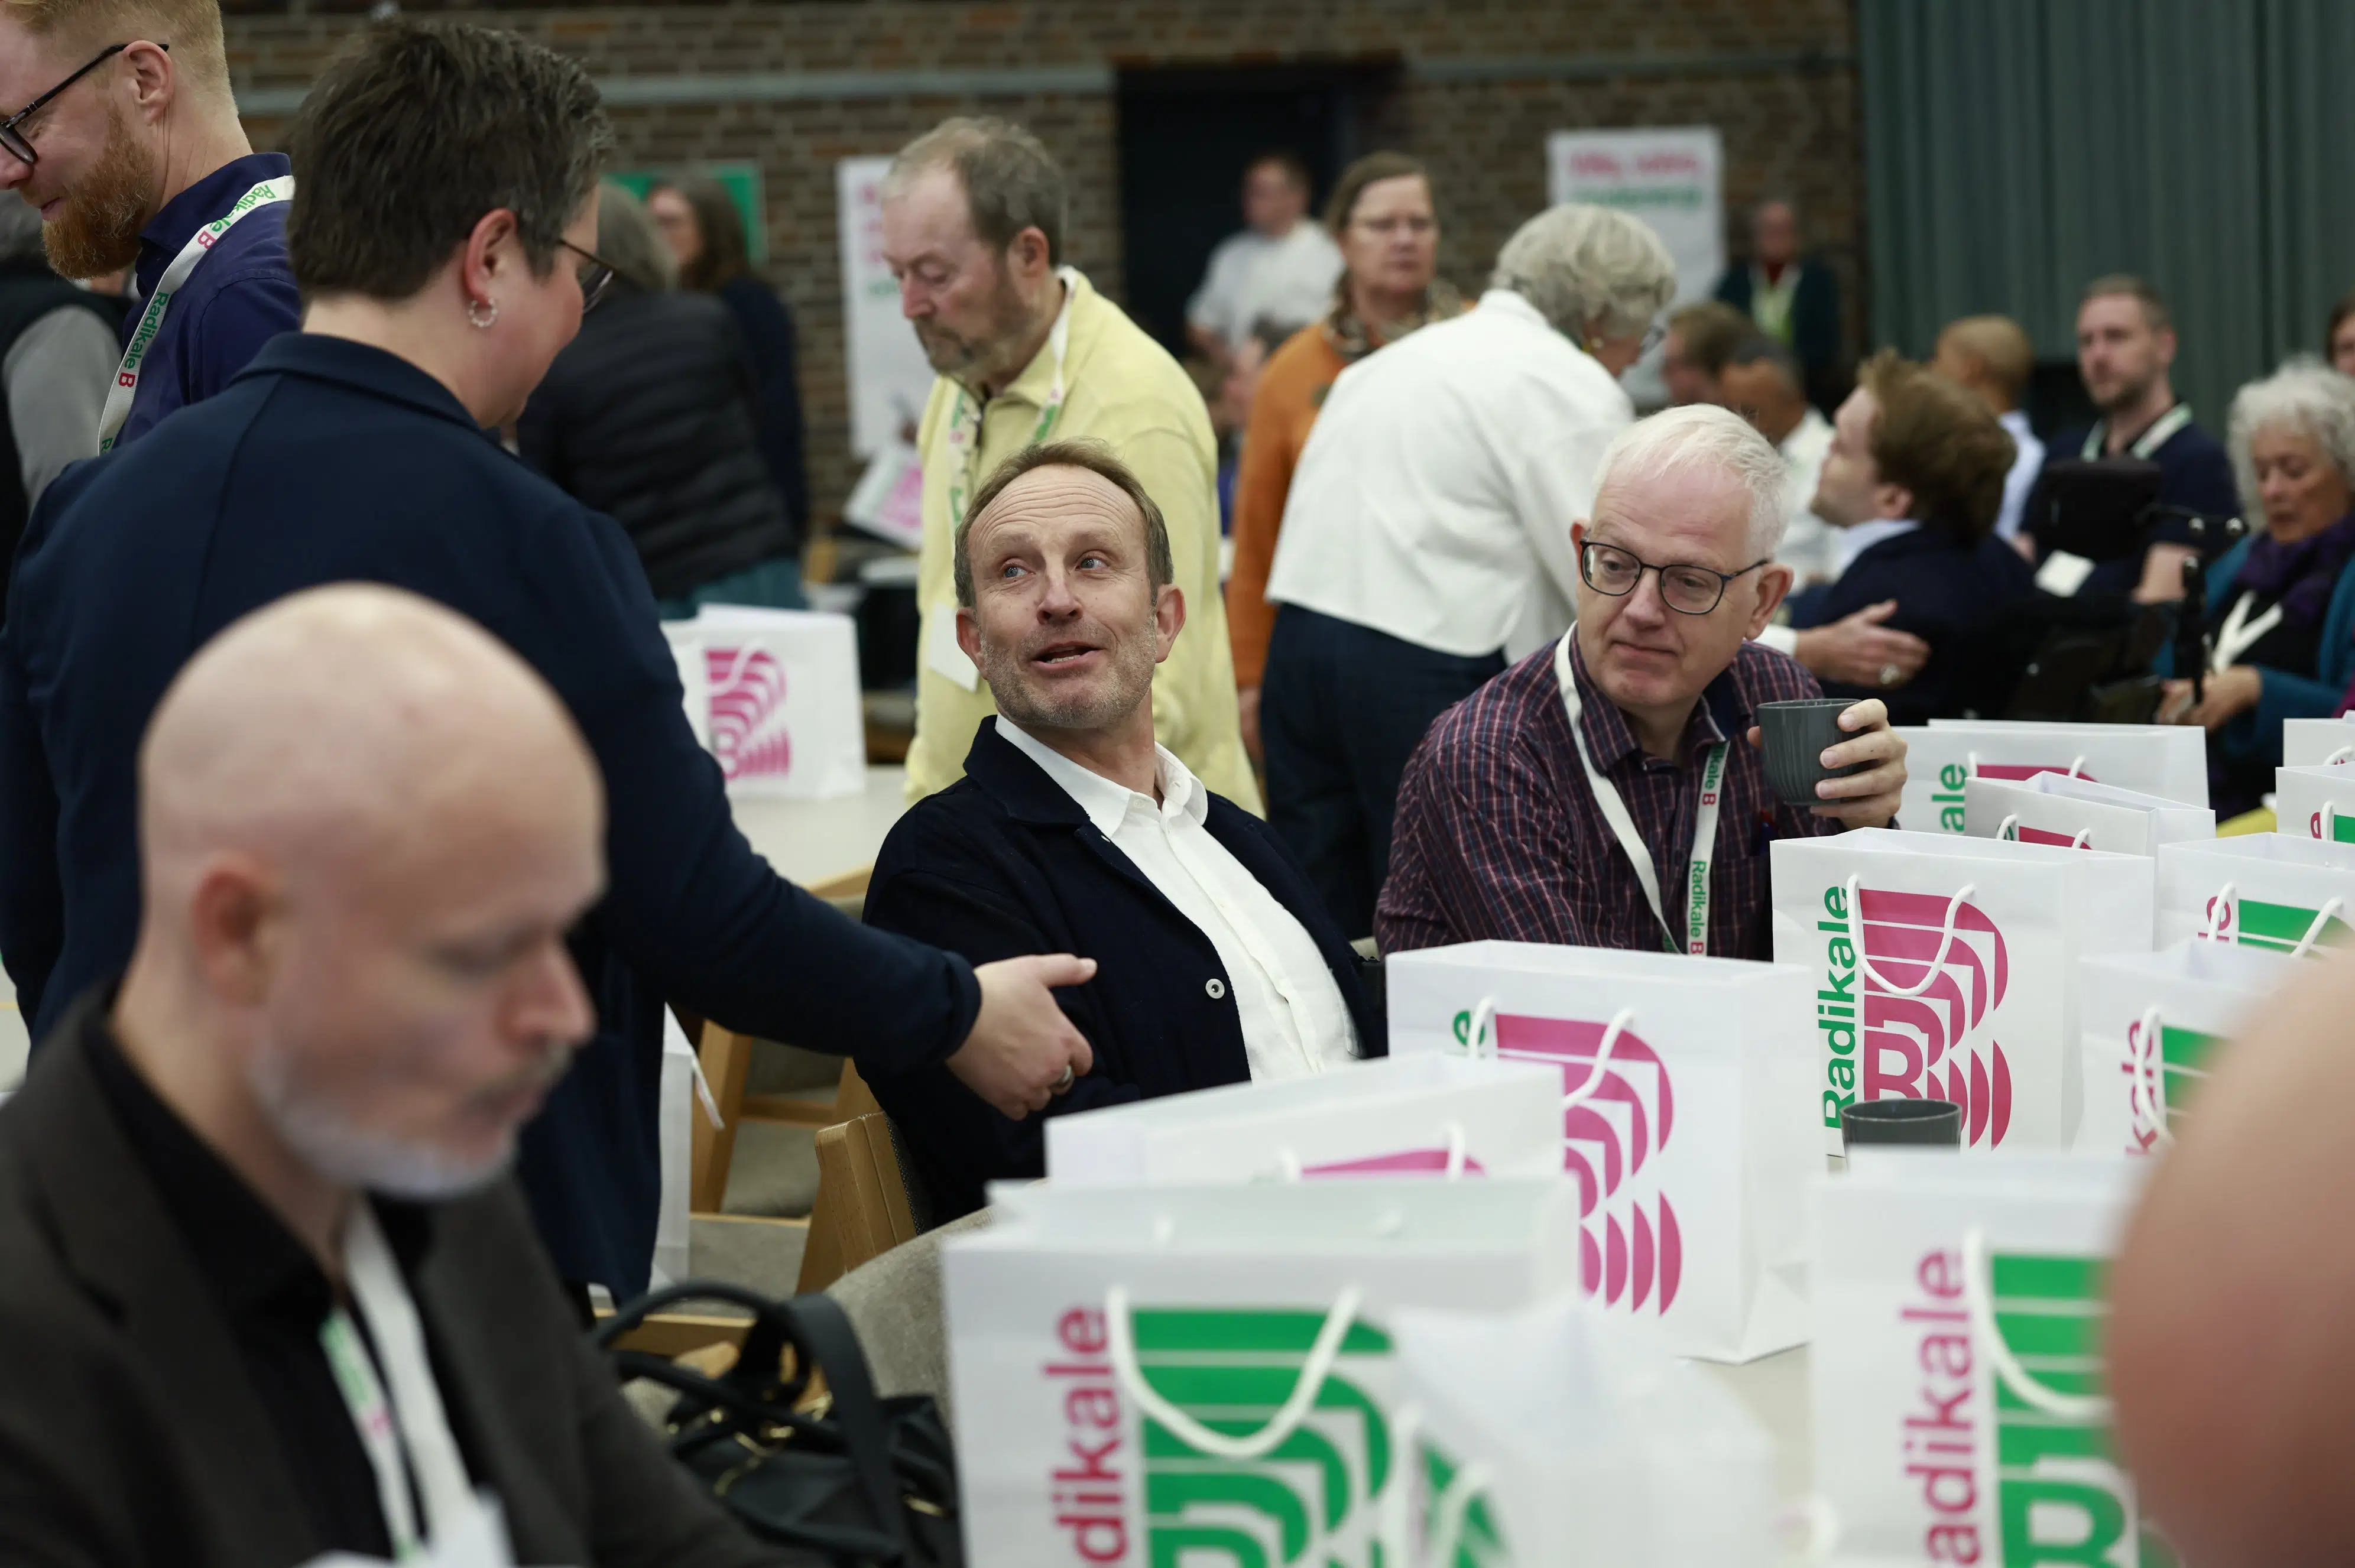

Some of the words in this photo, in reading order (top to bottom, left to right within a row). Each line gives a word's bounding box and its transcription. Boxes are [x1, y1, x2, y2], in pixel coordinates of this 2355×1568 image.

[209, 184, 276, 232] Radikle
[197, 230, 217, 249] B
[124, 291, 169, 370] Radikale
[118, 372, 136, 388] B
[1702, 793, 1717, 806] B
[1690, 860, 1707, 938] Radikale
[1691, 941, 1705, 955] B
[1818, 886, 1857, 1129] Radikale
